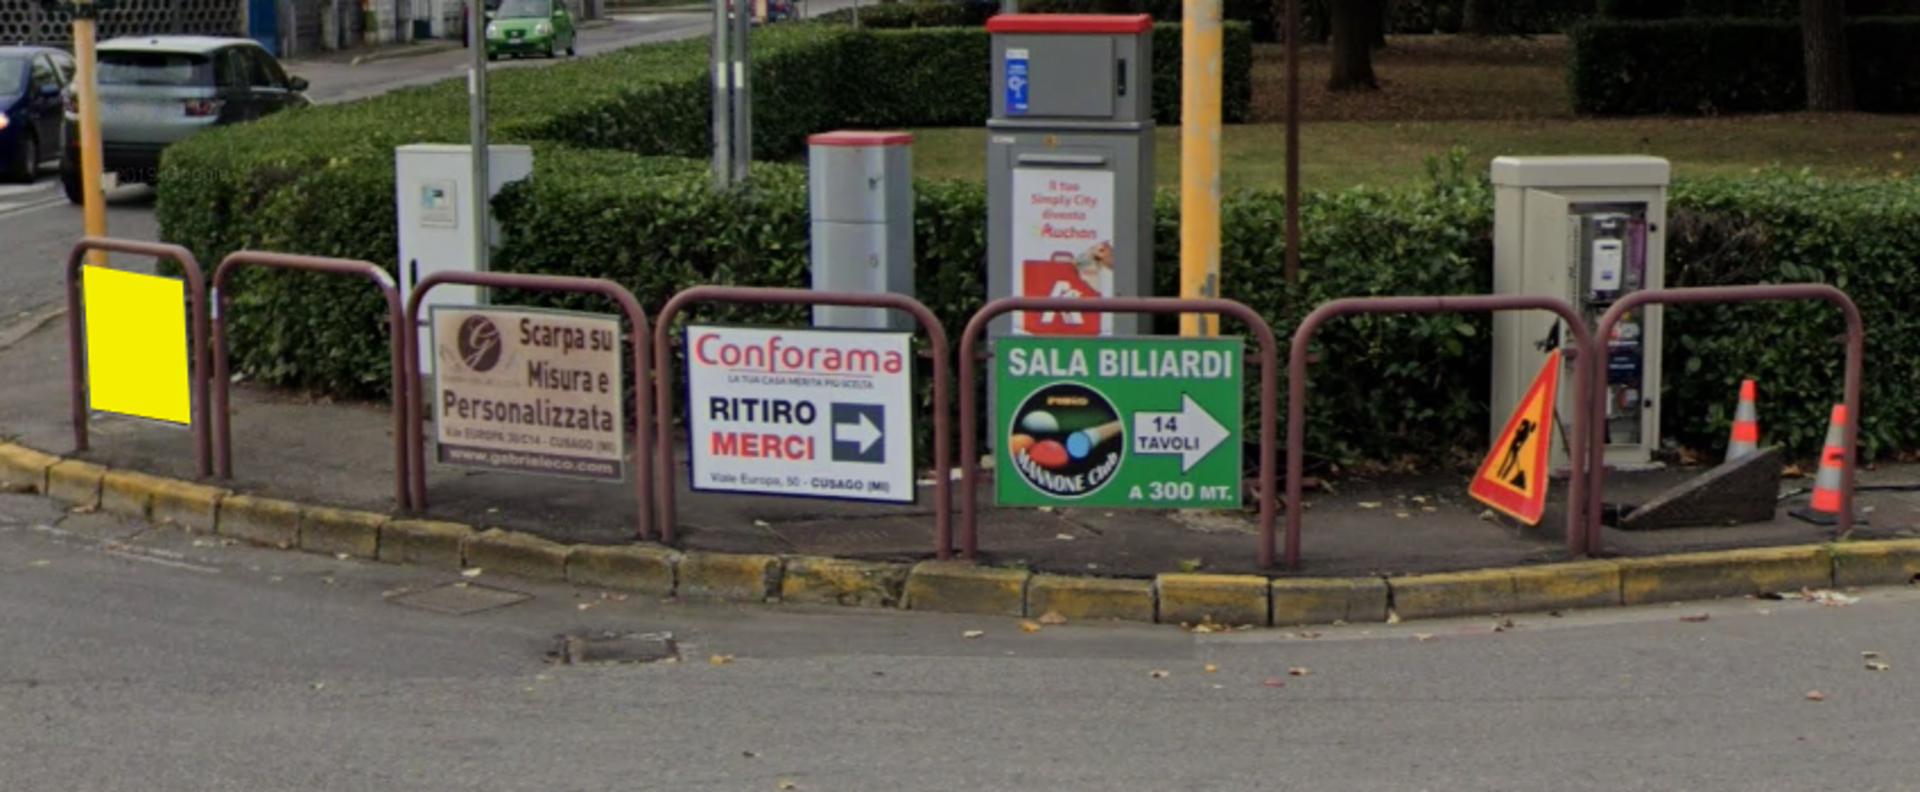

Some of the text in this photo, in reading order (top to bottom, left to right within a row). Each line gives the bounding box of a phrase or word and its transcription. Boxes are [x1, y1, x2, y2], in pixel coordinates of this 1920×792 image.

[1031, 193, 1097, 208] Simply City
[1041, 224, 1097, 239] Auchan
[519, 318, 613, 355] Scarpa su
[694, 333, 904, 374] Conforama
[1008, 347, 1233, 379] SALA BILIARDI
[528, 360, 609, 394] Misura e
[727, 375, 740, 384] LA
[761, 376, 785, 386] CASA
[442, 389, 614, 432] Personalizzata
[709, 396, 817, 425] RITIRO
[1152, 416, 1178, 432] 14
[710, 432, 815, 461] MERCI
[1137, 435, 1200, 450] TAVOLI
[710, 472, 737, 485] Viale
[810, 477, 863, 491] CUSAGO
[867, 480, 891, 494] (MI)
[1128, 482, 1233, 501] A 300 MT.
